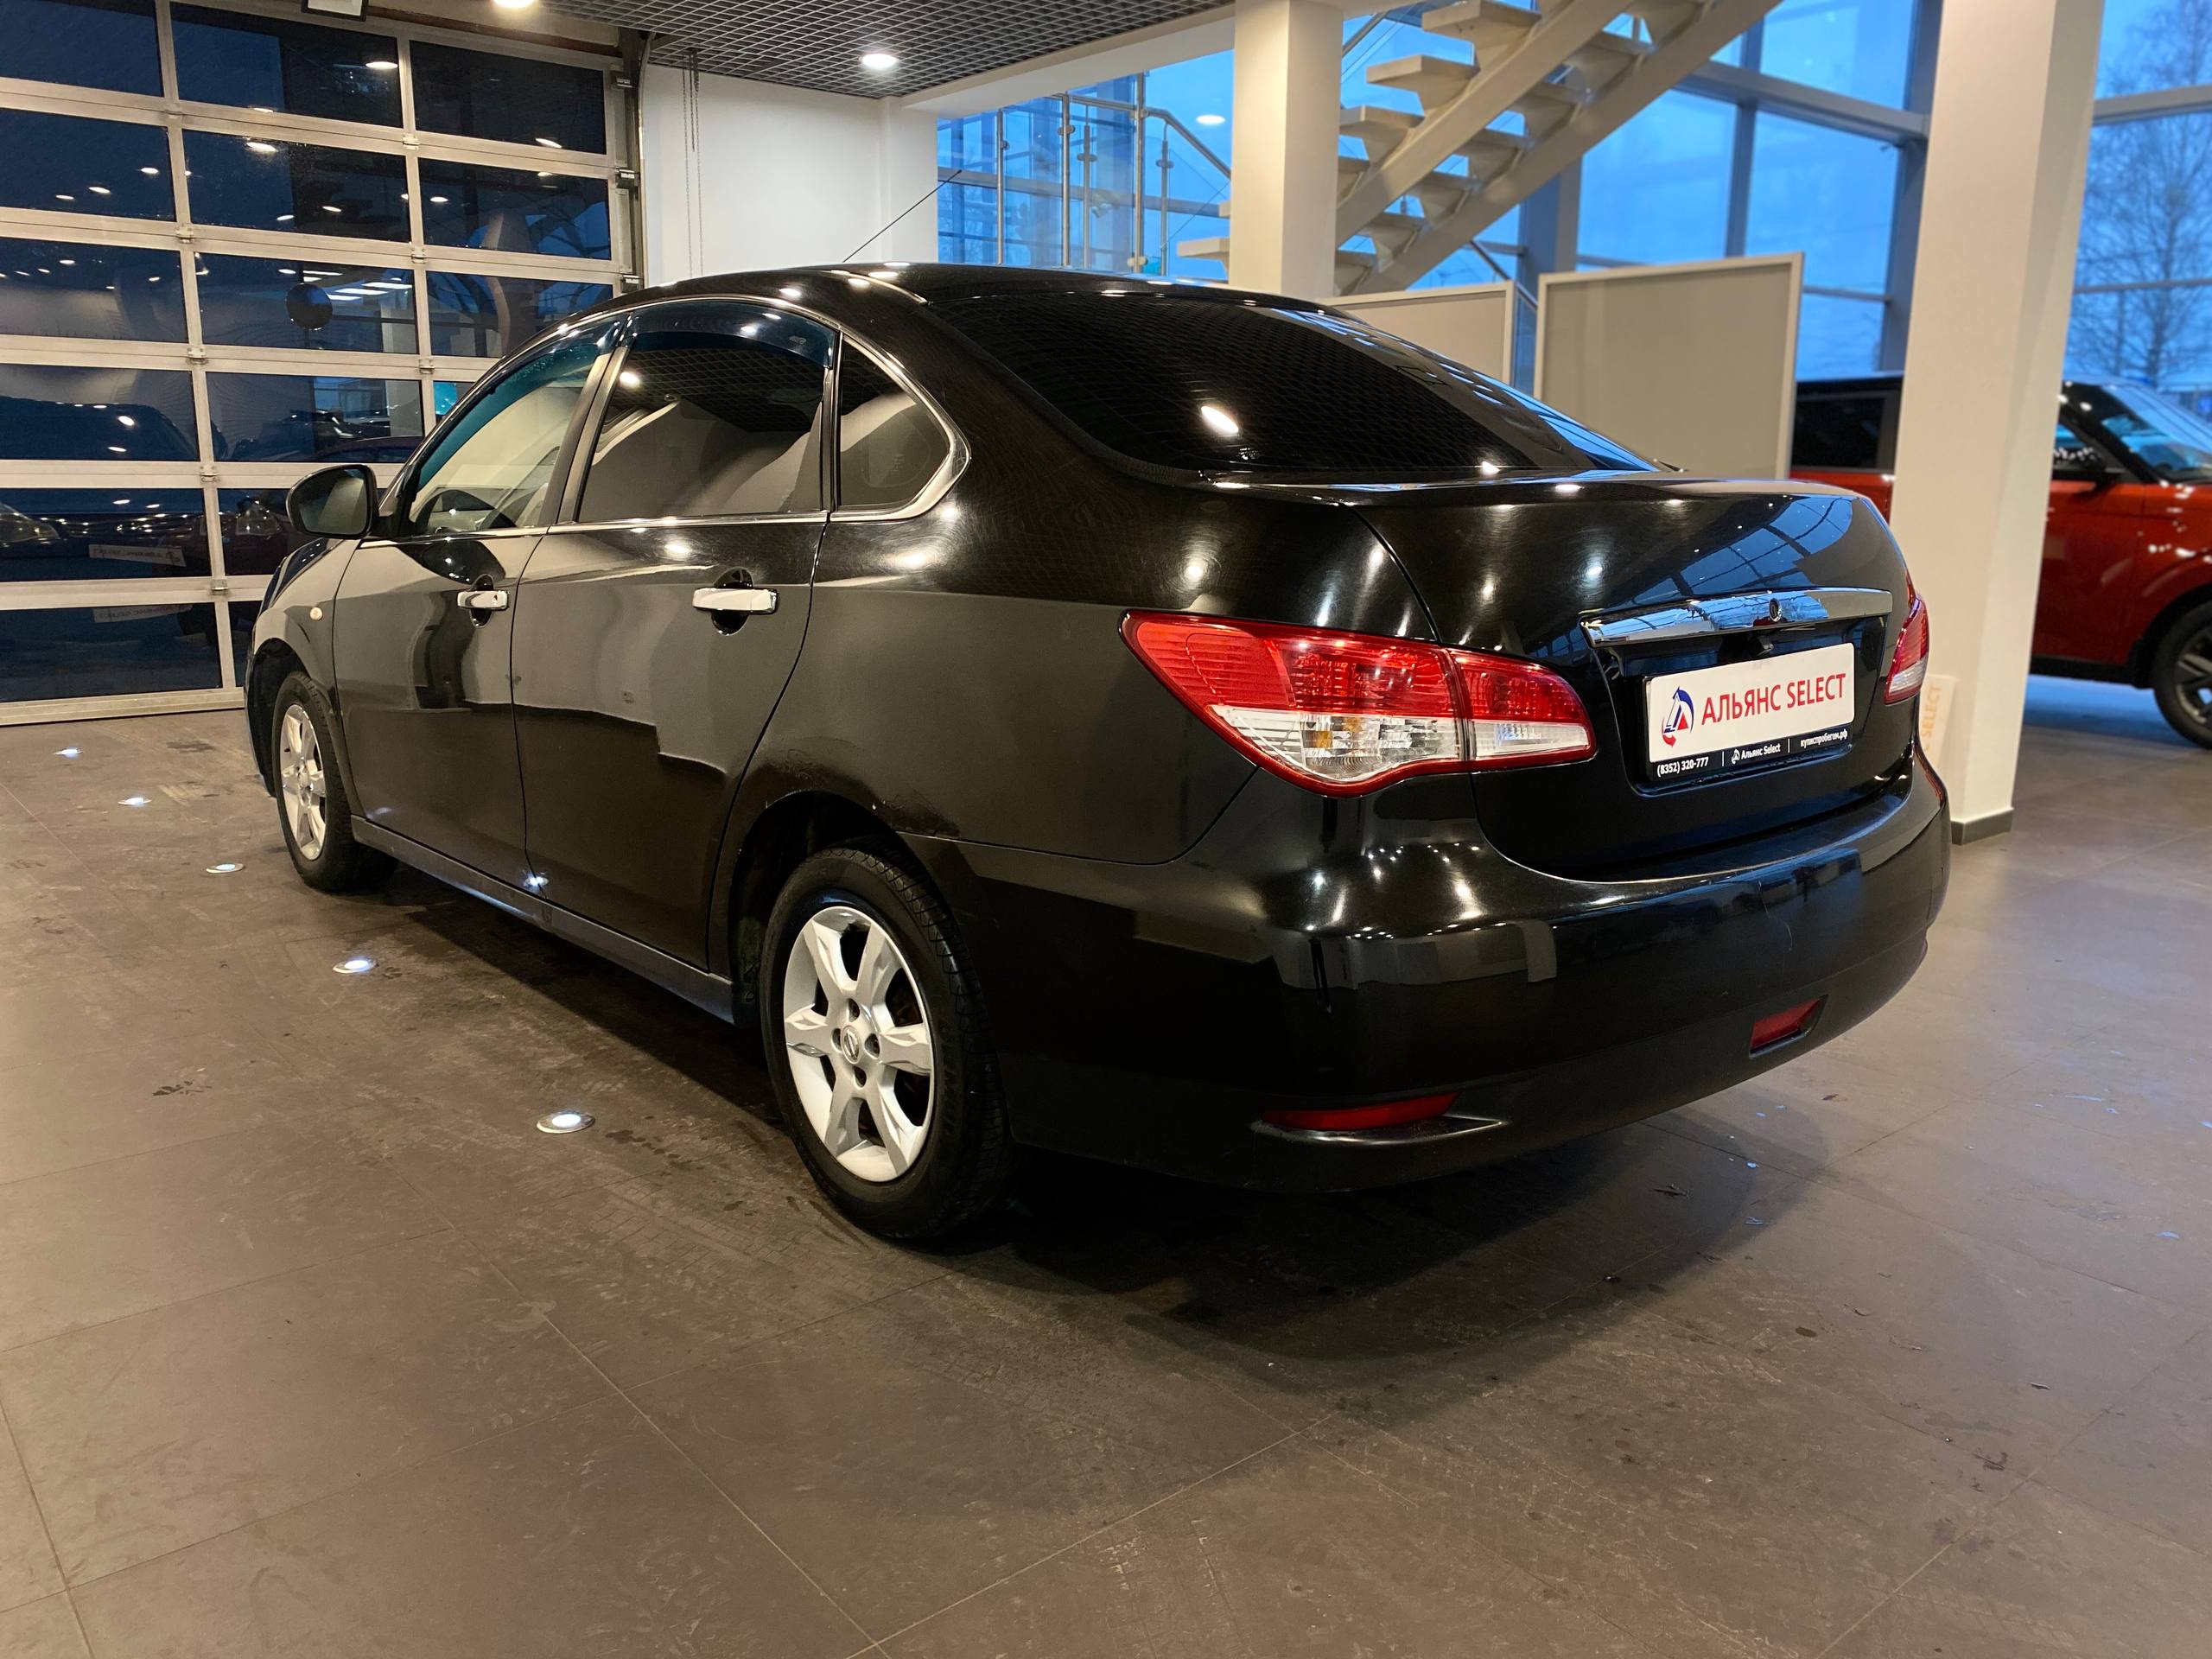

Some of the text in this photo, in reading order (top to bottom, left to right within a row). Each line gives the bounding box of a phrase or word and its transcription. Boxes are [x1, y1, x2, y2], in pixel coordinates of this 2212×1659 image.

[1700, 673, 1847, 725] АЛЬЯНС SELECT
[1740, 742, 1781, 760] Альянс Select
[1656, 756, 1709, 777] (8352) 320-777
